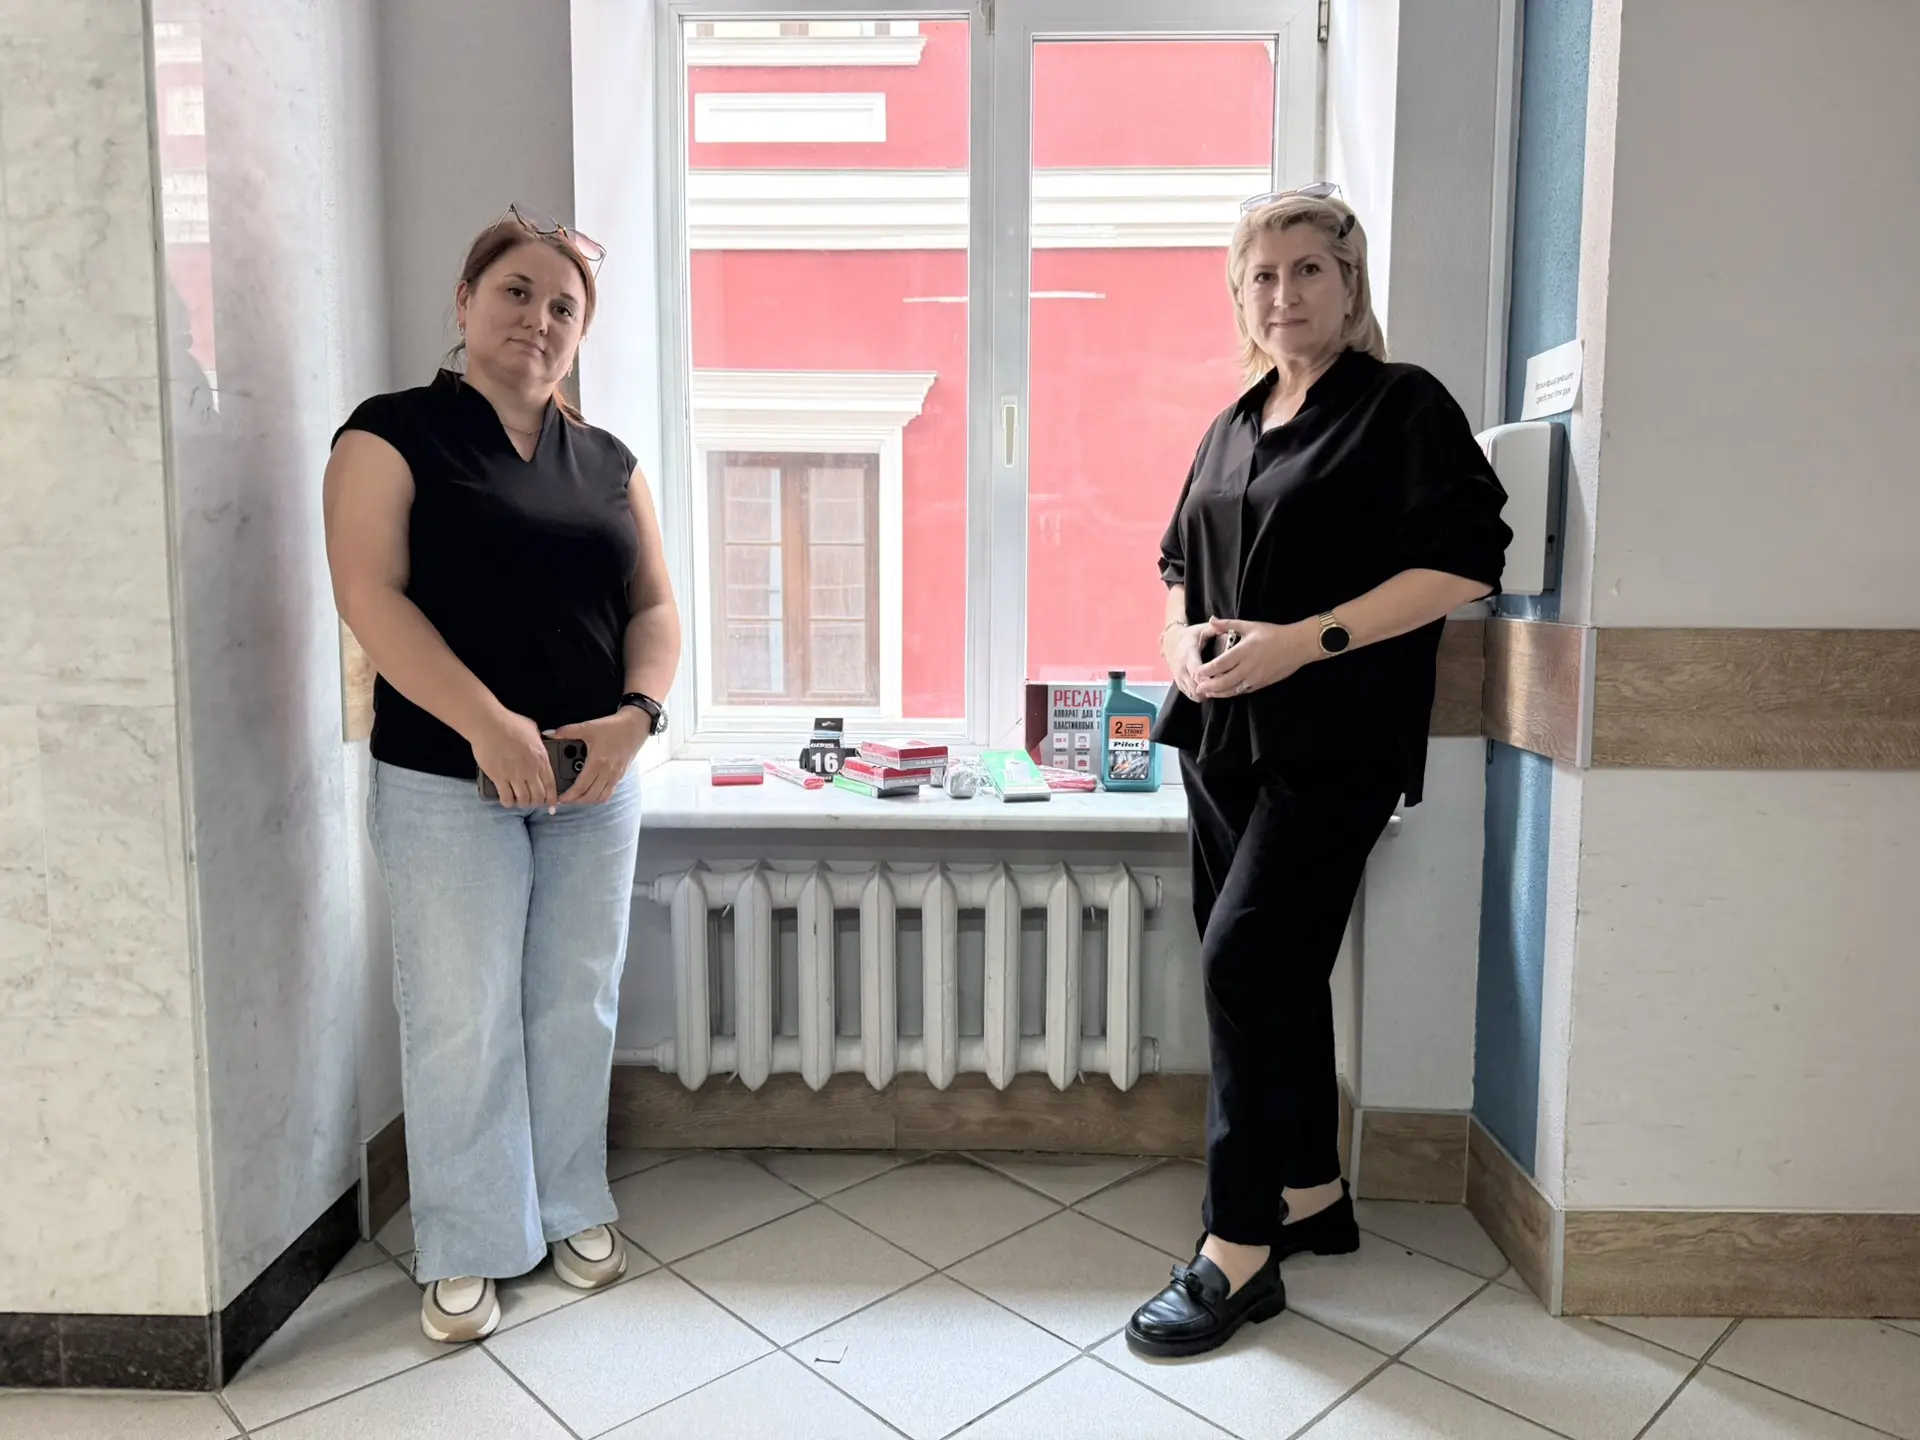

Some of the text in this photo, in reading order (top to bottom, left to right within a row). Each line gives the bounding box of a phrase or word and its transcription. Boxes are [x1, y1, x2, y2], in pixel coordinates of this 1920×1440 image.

[1054, 690, 1105, 707] РЕСАН
[1054, 709, 1078, 718] АППАРАТ
[1081, 709, 1093, 719] ДЛЯ
[1054, 721, 1094, 730] ПЛАСТИКОВЫХ
[1115, 721, 1123, 734] 2
[812, 752, 839, 773] 16
